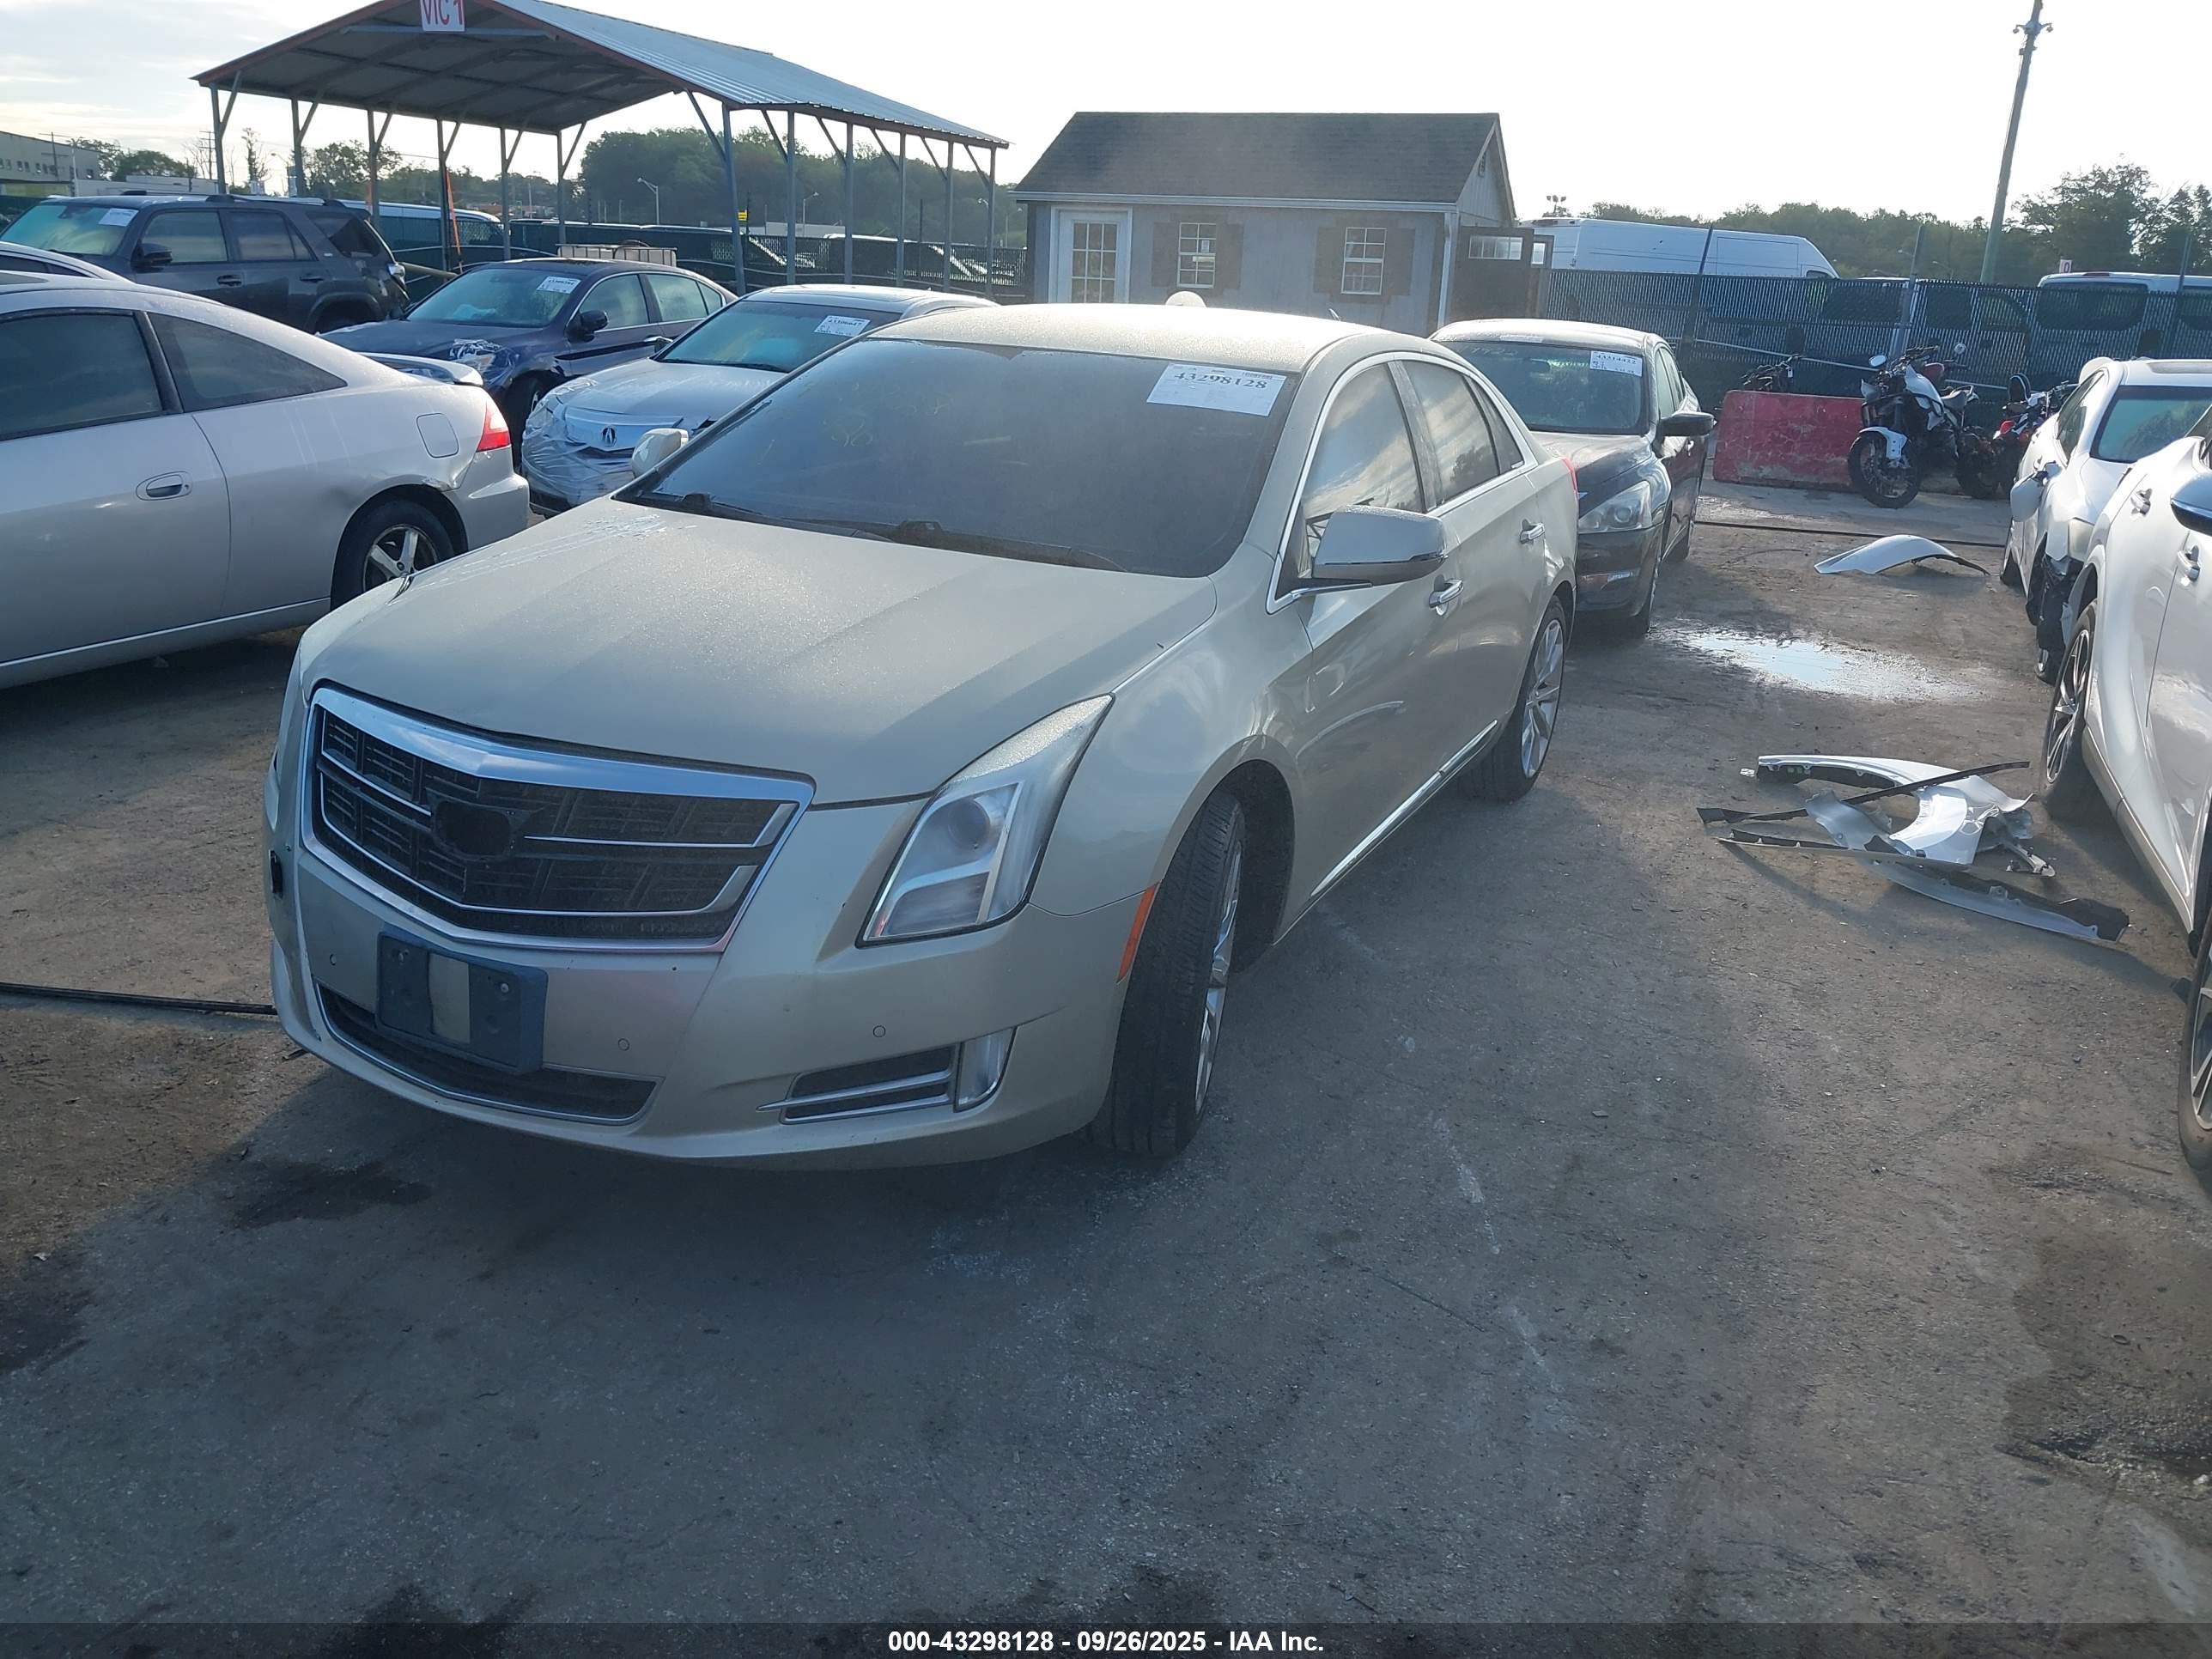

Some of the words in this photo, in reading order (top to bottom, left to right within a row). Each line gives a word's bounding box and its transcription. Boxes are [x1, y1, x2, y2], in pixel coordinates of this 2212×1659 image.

[422, 0, 450, 25] VIC
[453, 0, 463, 25] 1
[1174, 372, 1267, 389] 43298128
